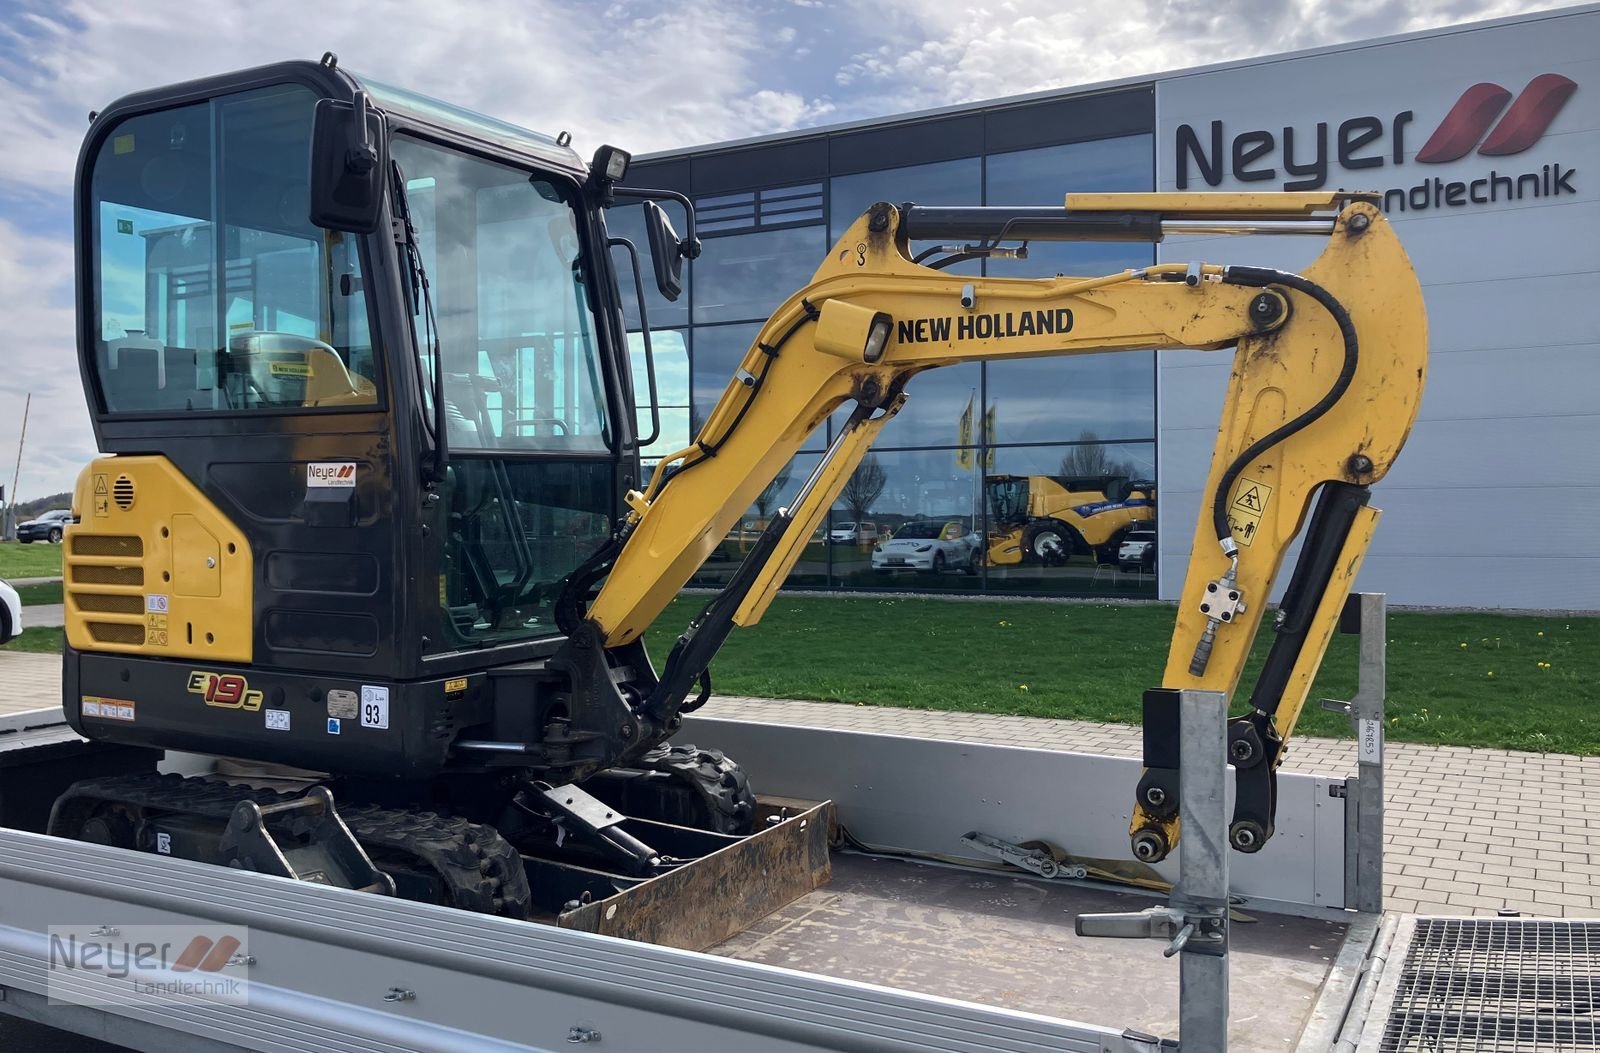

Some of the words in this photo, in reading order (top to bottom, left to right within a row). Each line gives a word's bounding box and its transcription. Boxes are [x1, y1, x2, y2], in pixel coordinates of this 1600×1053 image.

[1176, 111, 1413, 192] Neyer
[1339, 163, 1577, 213] ndtechnik
[898, 317, 951, 344] NEW
[957, 308, 1074, 340] HOLLAND
[309, 465, 337, 479] Neyer
[365, 704, 379, 724] 93
